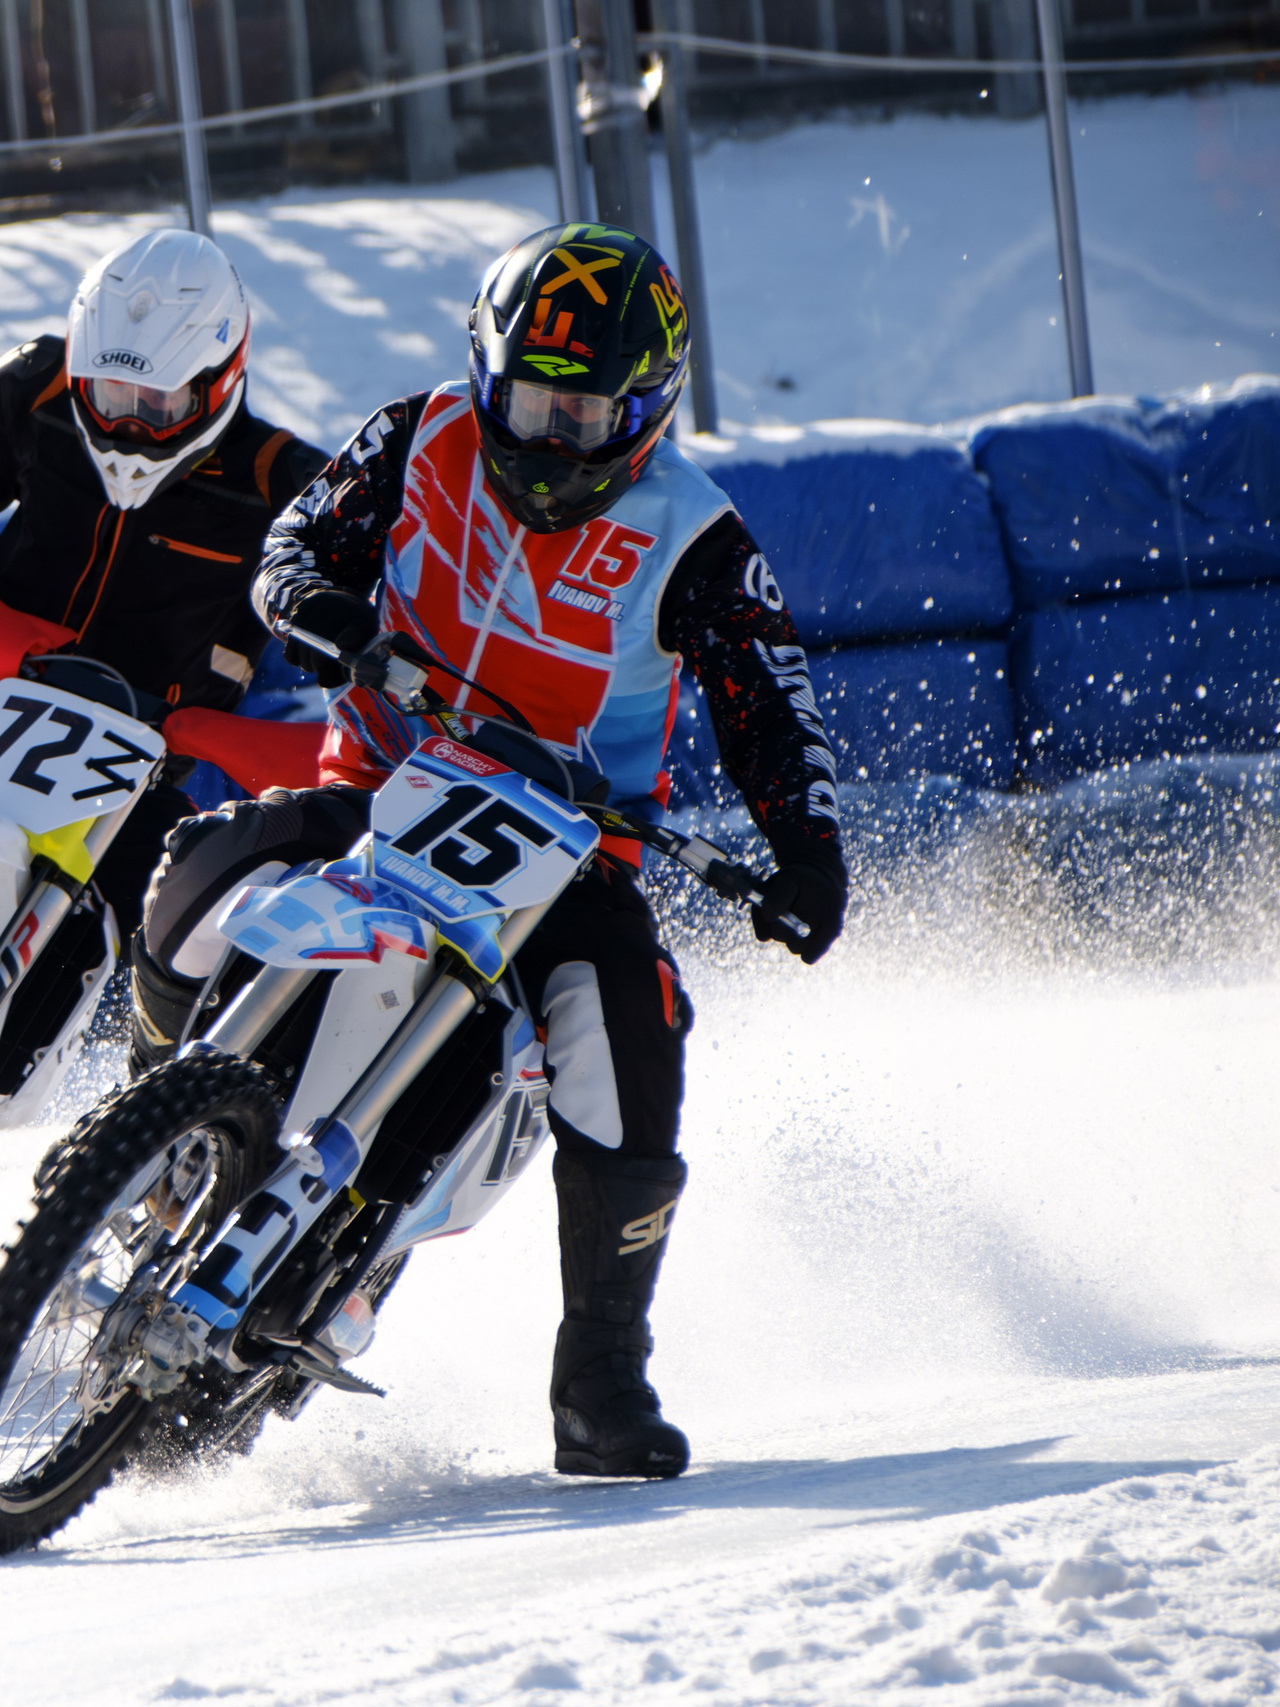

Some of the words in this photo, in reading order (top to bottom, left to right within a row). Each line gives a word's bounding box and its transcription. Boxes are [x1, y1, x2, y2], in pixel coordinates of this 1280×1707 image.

[99, 352, 146, 371] SHOEI
[559, 517, 660, 592] 15
[546, 579, 608, 614] IVANOV
[606, 599, 624, 622] M.
[448, 754, 487, 775] RACING
[391, 784, 558, 887] 15
[380, 856, 439, 890] IVANOV
[431, 883, 473, 915] M.M.
